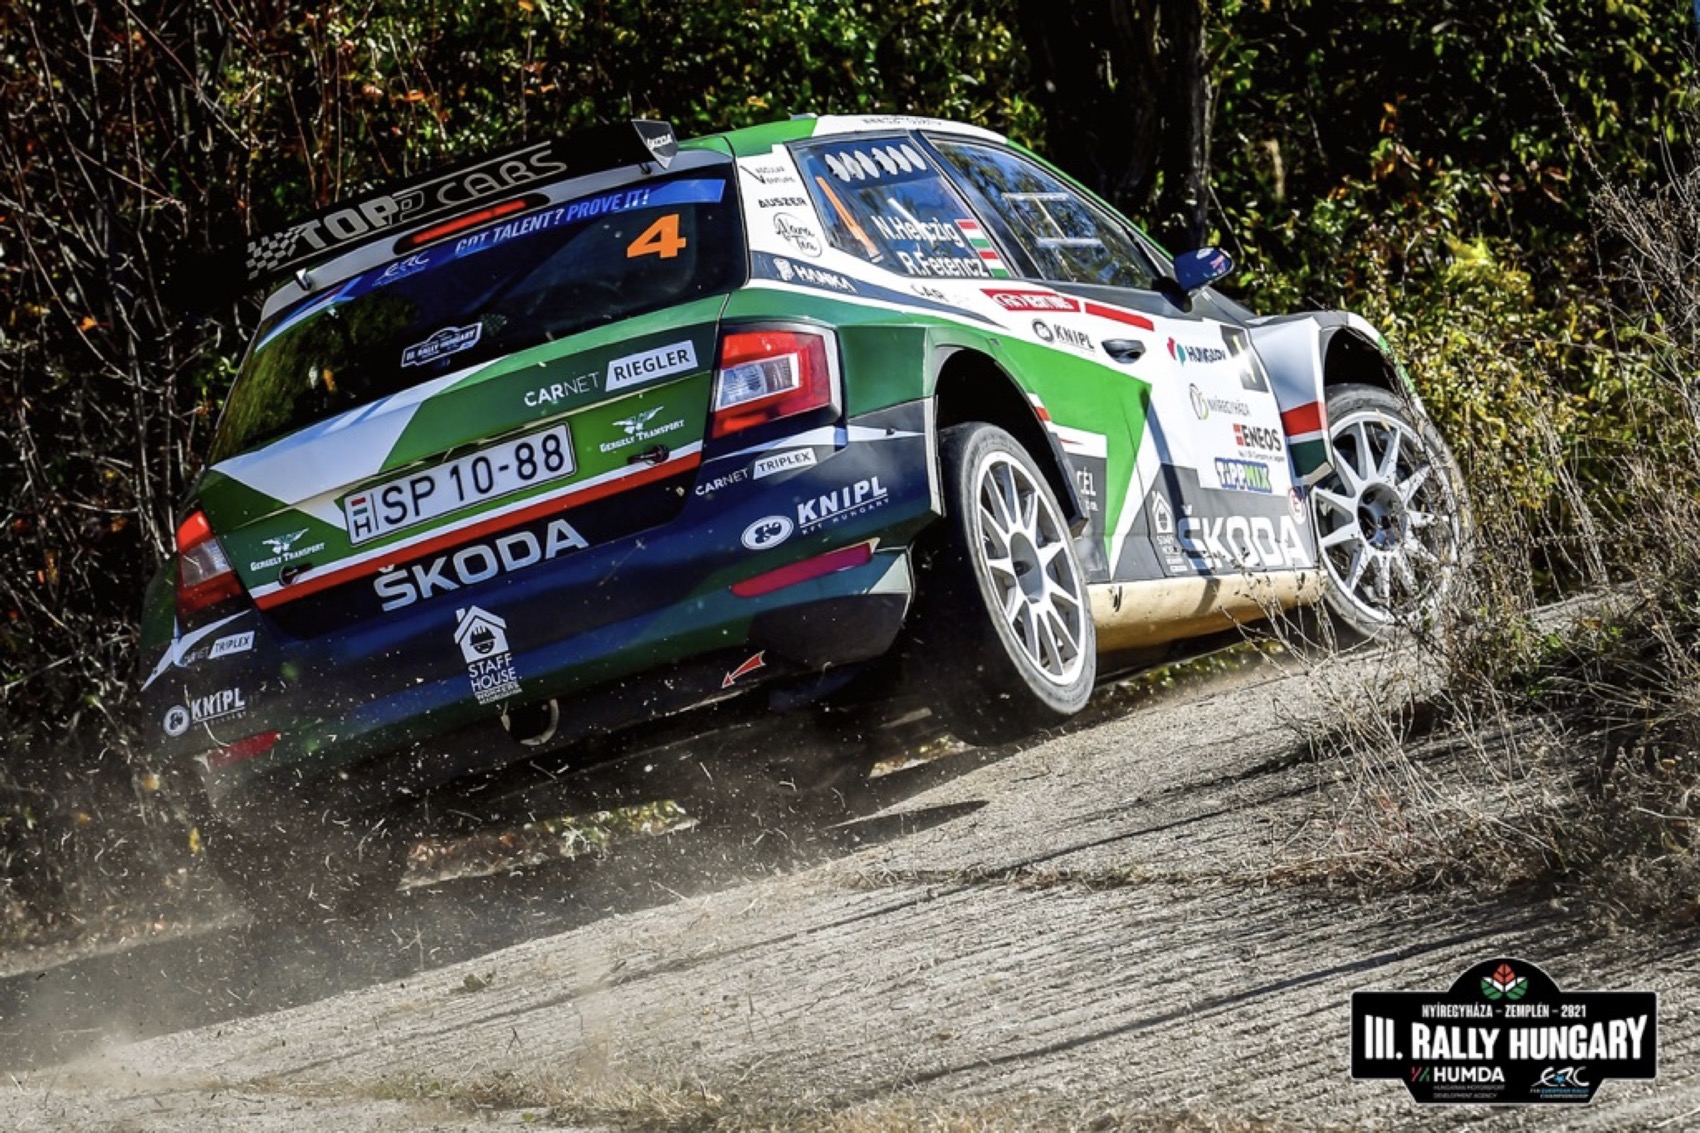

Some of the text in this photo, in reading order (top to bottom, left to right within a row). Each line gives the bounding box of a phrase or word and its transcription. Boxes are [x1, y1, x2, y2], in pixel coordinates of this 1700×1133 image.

[437, 149, 567, 205] CARS
[454, 188, 651, 256] GOT TALENT? PROVE IT!
[626, 213, 687, 260] 4
[1054, 324, 1095, 350] KNIPL
[524, 349, 691, 407] CARNET RIEGLER
[1241, 424, 1282, 452] ENEOS
[381, 433, 565, 526] SP 10-88
[694, 451, 812, 497] CARNET TRIPLEX
[797, 475, 888, 525] KNIPL
[354, 516, 372, 537] H
[1178, 503, 1313, 571] ŠKODA
[373, 518, 589, 613] ŠKODA
[214, 638, 250, 652] TRIPLEX
[468, 652, 513, 678] STAFF
[470, 666, 517, 693] HOUSE
[190, 687, 246, 719] KNIPL
